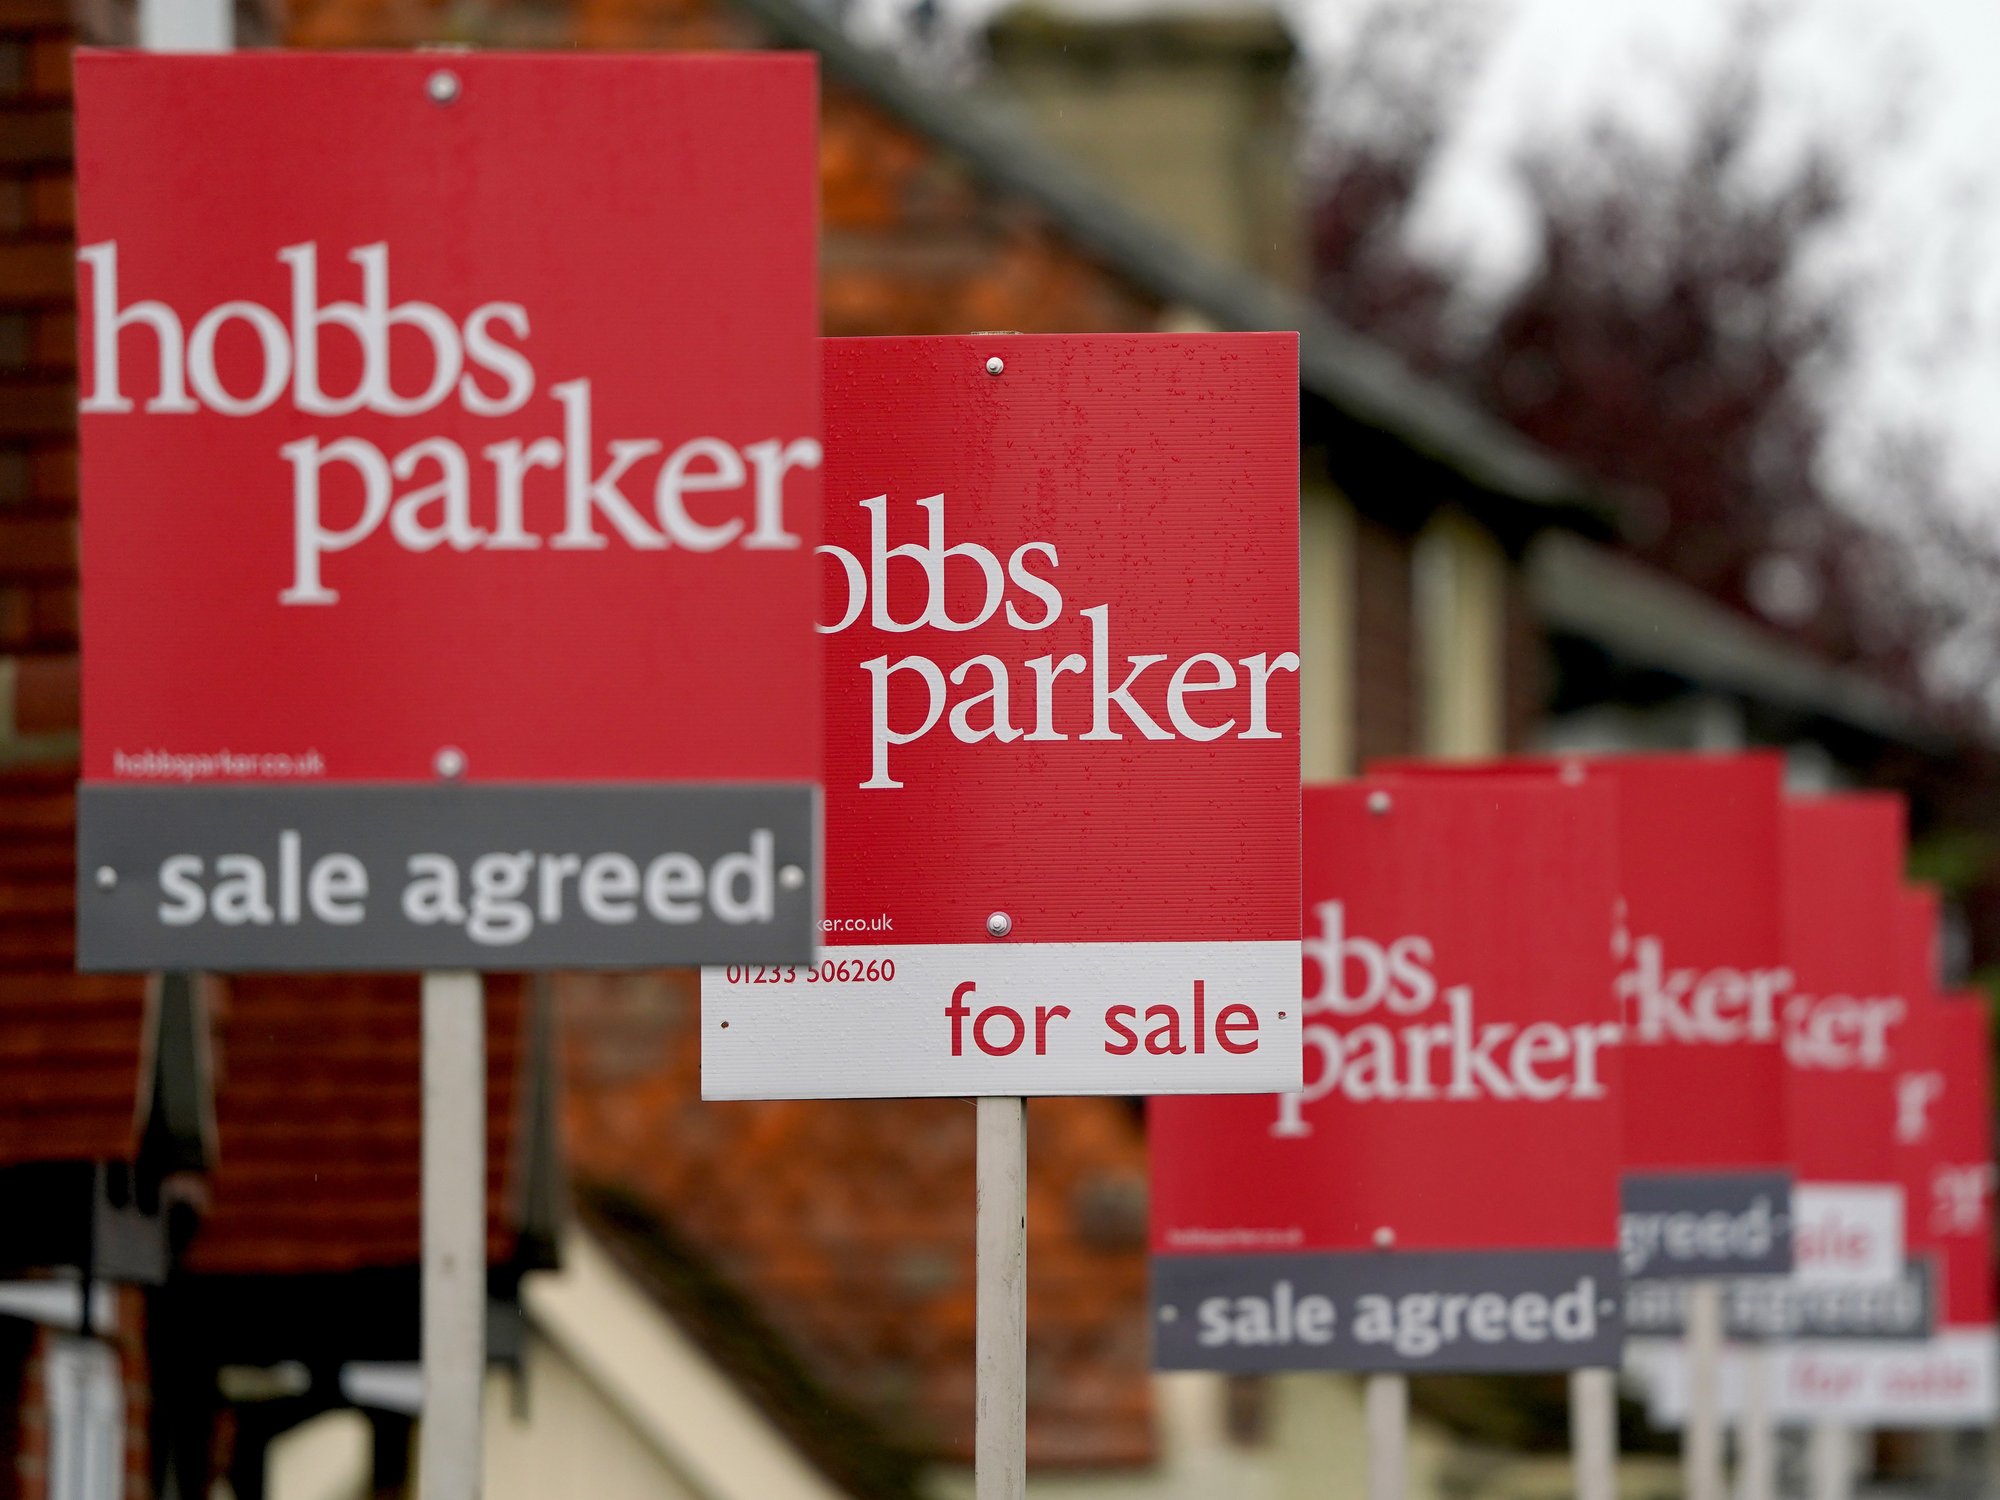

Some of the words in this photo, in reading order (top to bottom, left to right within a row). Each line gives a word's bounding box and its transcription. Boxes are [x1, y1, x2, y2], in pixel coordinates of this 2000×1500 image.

[79, 241, 535, 417] hobbs
[279, 379, 822, 606] parker
[814, 493, 1063, 634] obbs
[859, 604, 1301, 789] parker
[158, 830, 368, 926] sale
[402, 830, 775, 946] agreed
[726, 963, 796, 984] 01233
[806, 958, 895, 983] 506260
[945, 981, 1071, 1057] for
[1104, 980, 1260, 1056] sale
[1197, 1279, 1336, 1346] sale
[1352, 1276, 1595, 1357] agreed
